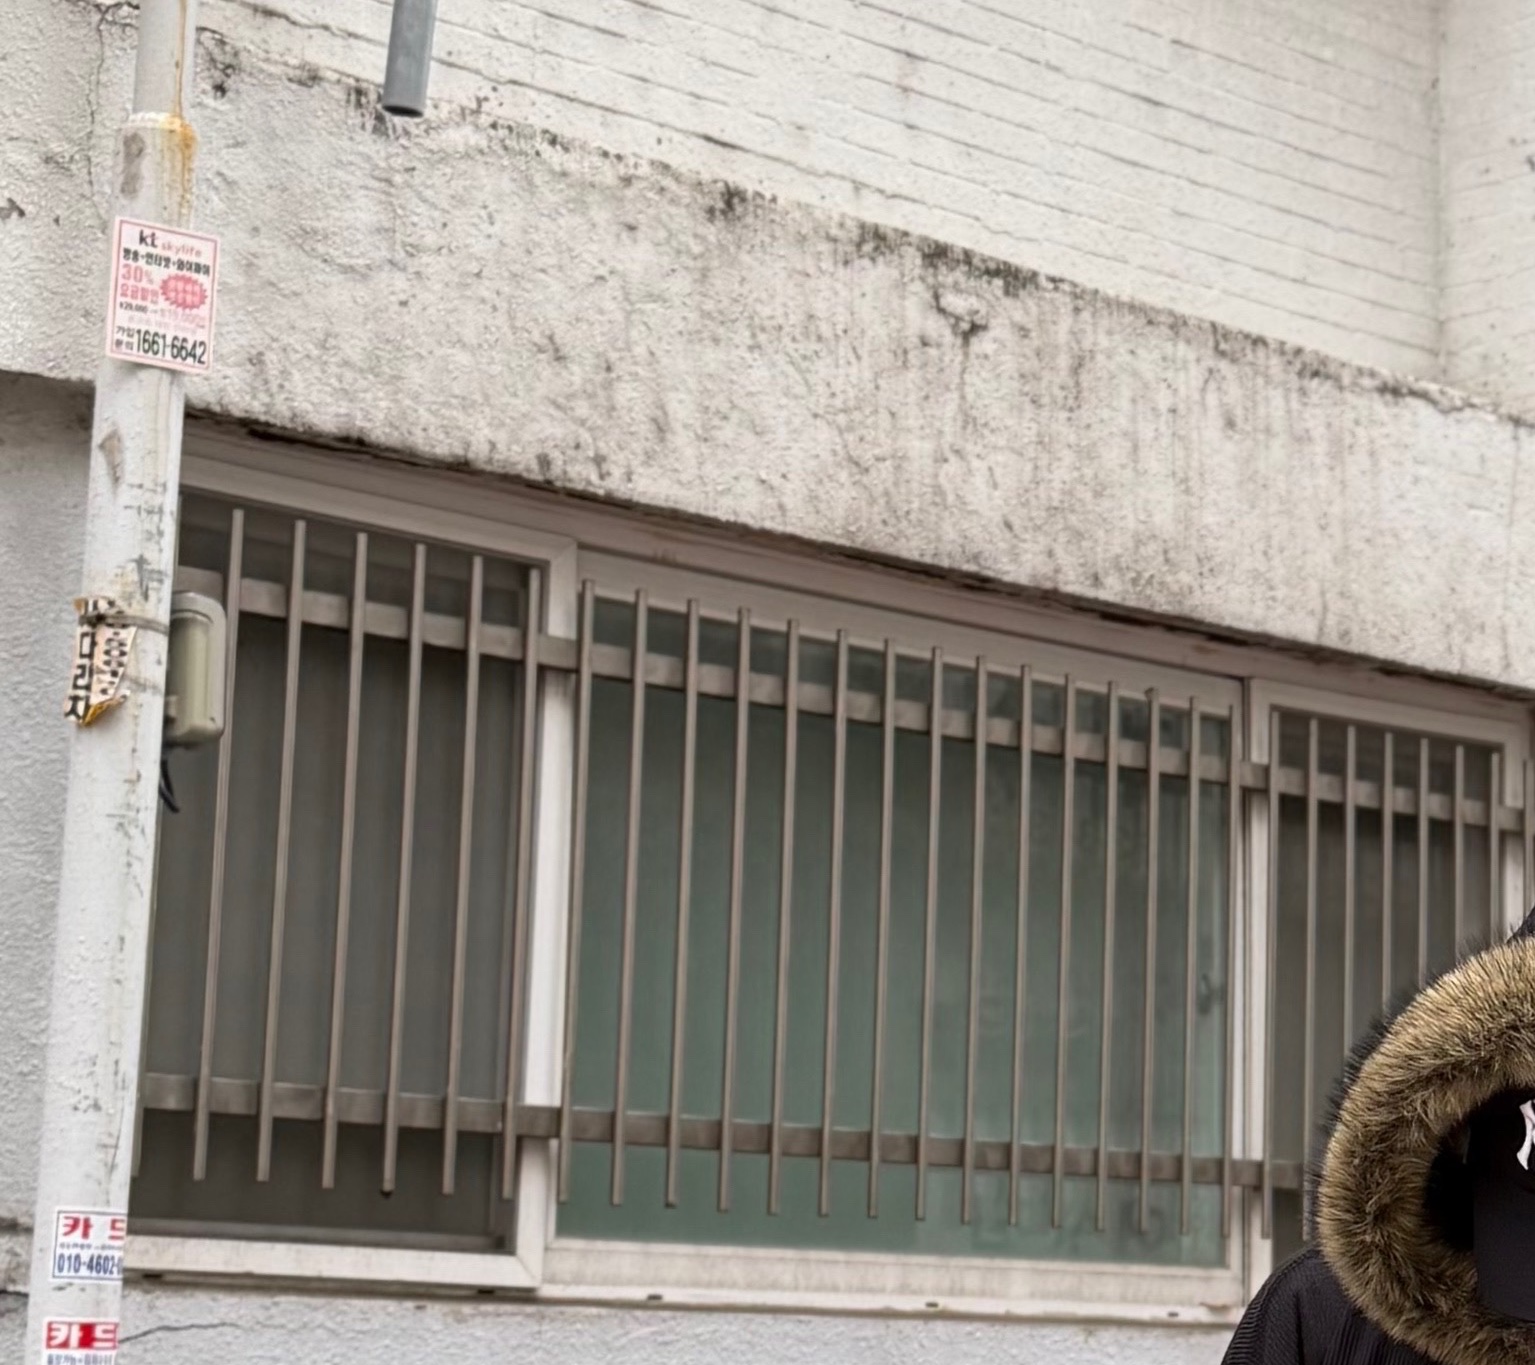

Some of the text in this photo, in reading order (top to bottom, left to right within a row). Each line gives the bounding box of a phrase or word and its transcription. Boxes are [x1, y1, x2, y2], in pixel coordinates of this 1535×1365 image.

[138, 229, 158, 249] kt
[136, 328, 208, 365] 1661-6642
[57, 1252, 122, 1275] 010-4602-
[49, 1323, 116, 1347] 카드
